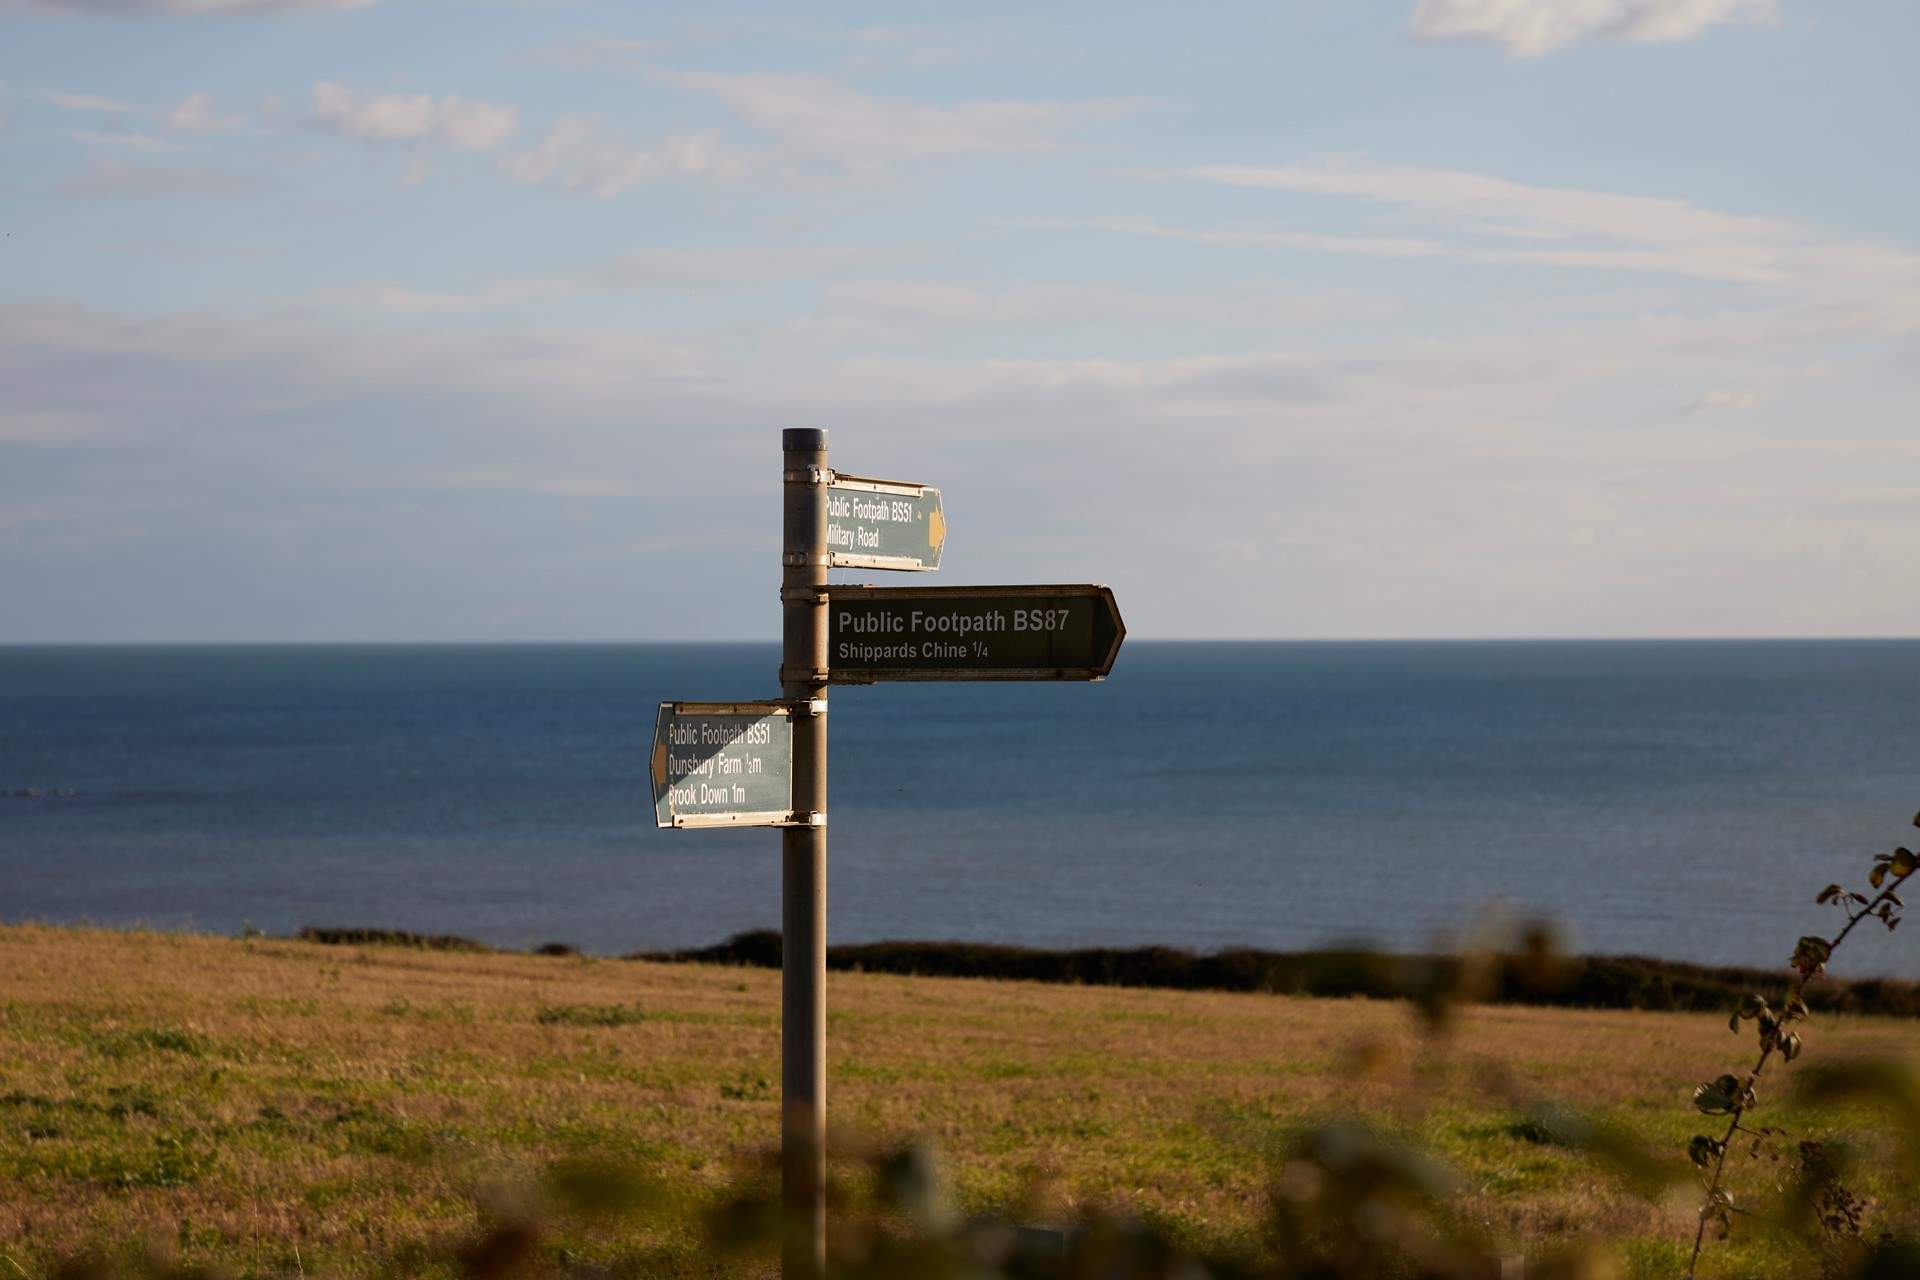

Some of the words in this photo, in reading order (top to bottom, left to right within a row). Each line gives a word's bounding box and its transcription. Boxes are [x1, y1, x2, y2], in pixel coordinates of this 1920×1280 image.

[853, 498, 889, 523] Footpath
[892, 501, 912, 522] BS51
[858, 526, 879, 547] Road
[840, 611, 904, 633] Public
[911, 611, 1005, 637] Footpath
[1013, 609, 1069, 631] BS87
[840, 642, 917, 662] Shippards
[922, 642, 967, 658] Chine
[669, 723, 698, 744] Public
[702, 723, 744, 749] Footpath
[747, 723, 770, 744] BS51
[669, 754, 714, 779] Dunsbury
[718, 753, 741, 774] Farm
[669, 784, 697, 806] Brook
[701, 783, 728, 804] Down
[732, 782, 745, 803] 1m
